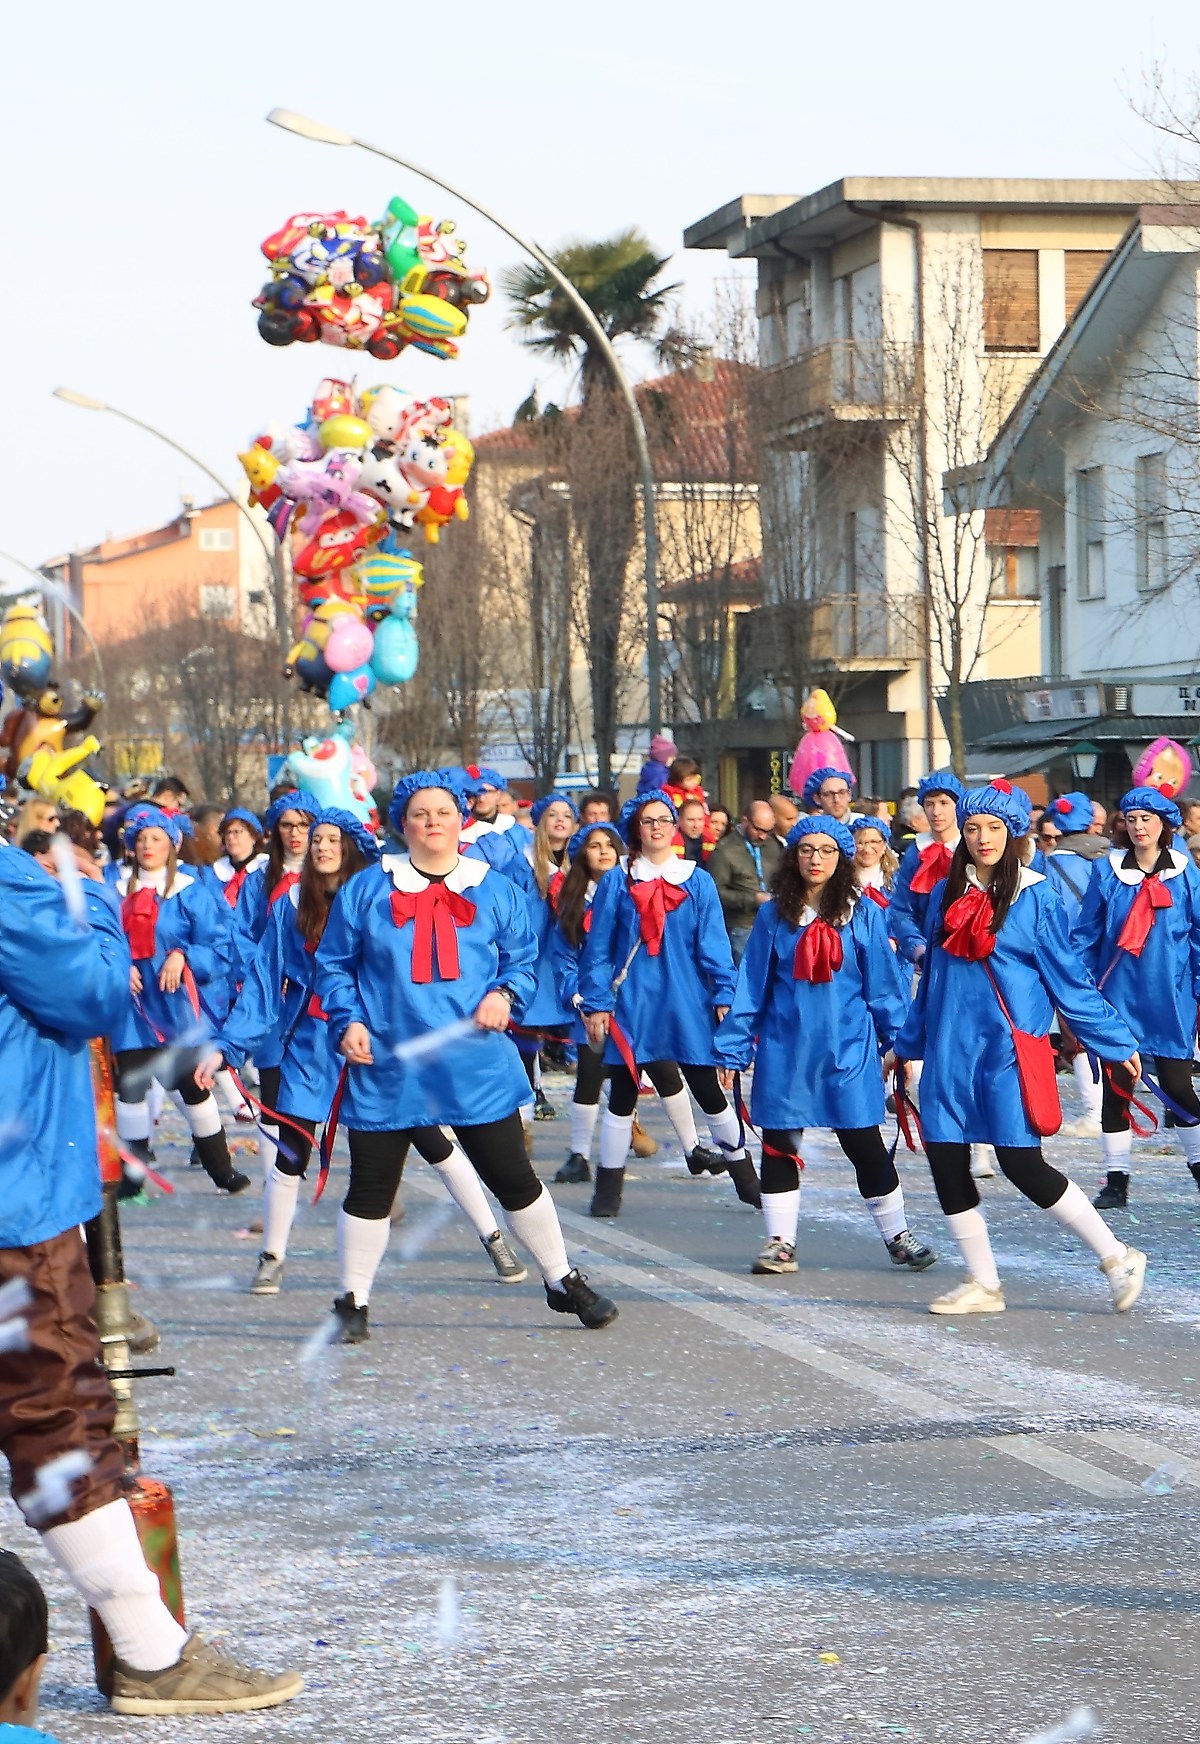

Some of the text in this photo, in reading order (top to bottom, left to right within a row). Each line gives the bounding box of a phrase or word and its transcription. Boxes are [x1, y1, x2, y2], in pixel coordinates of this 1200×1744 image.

[1179, 687, 1190, 698] IL
[1184, 700, 1196, 711] DI
[770, 751, 780, 796] FOTOC
